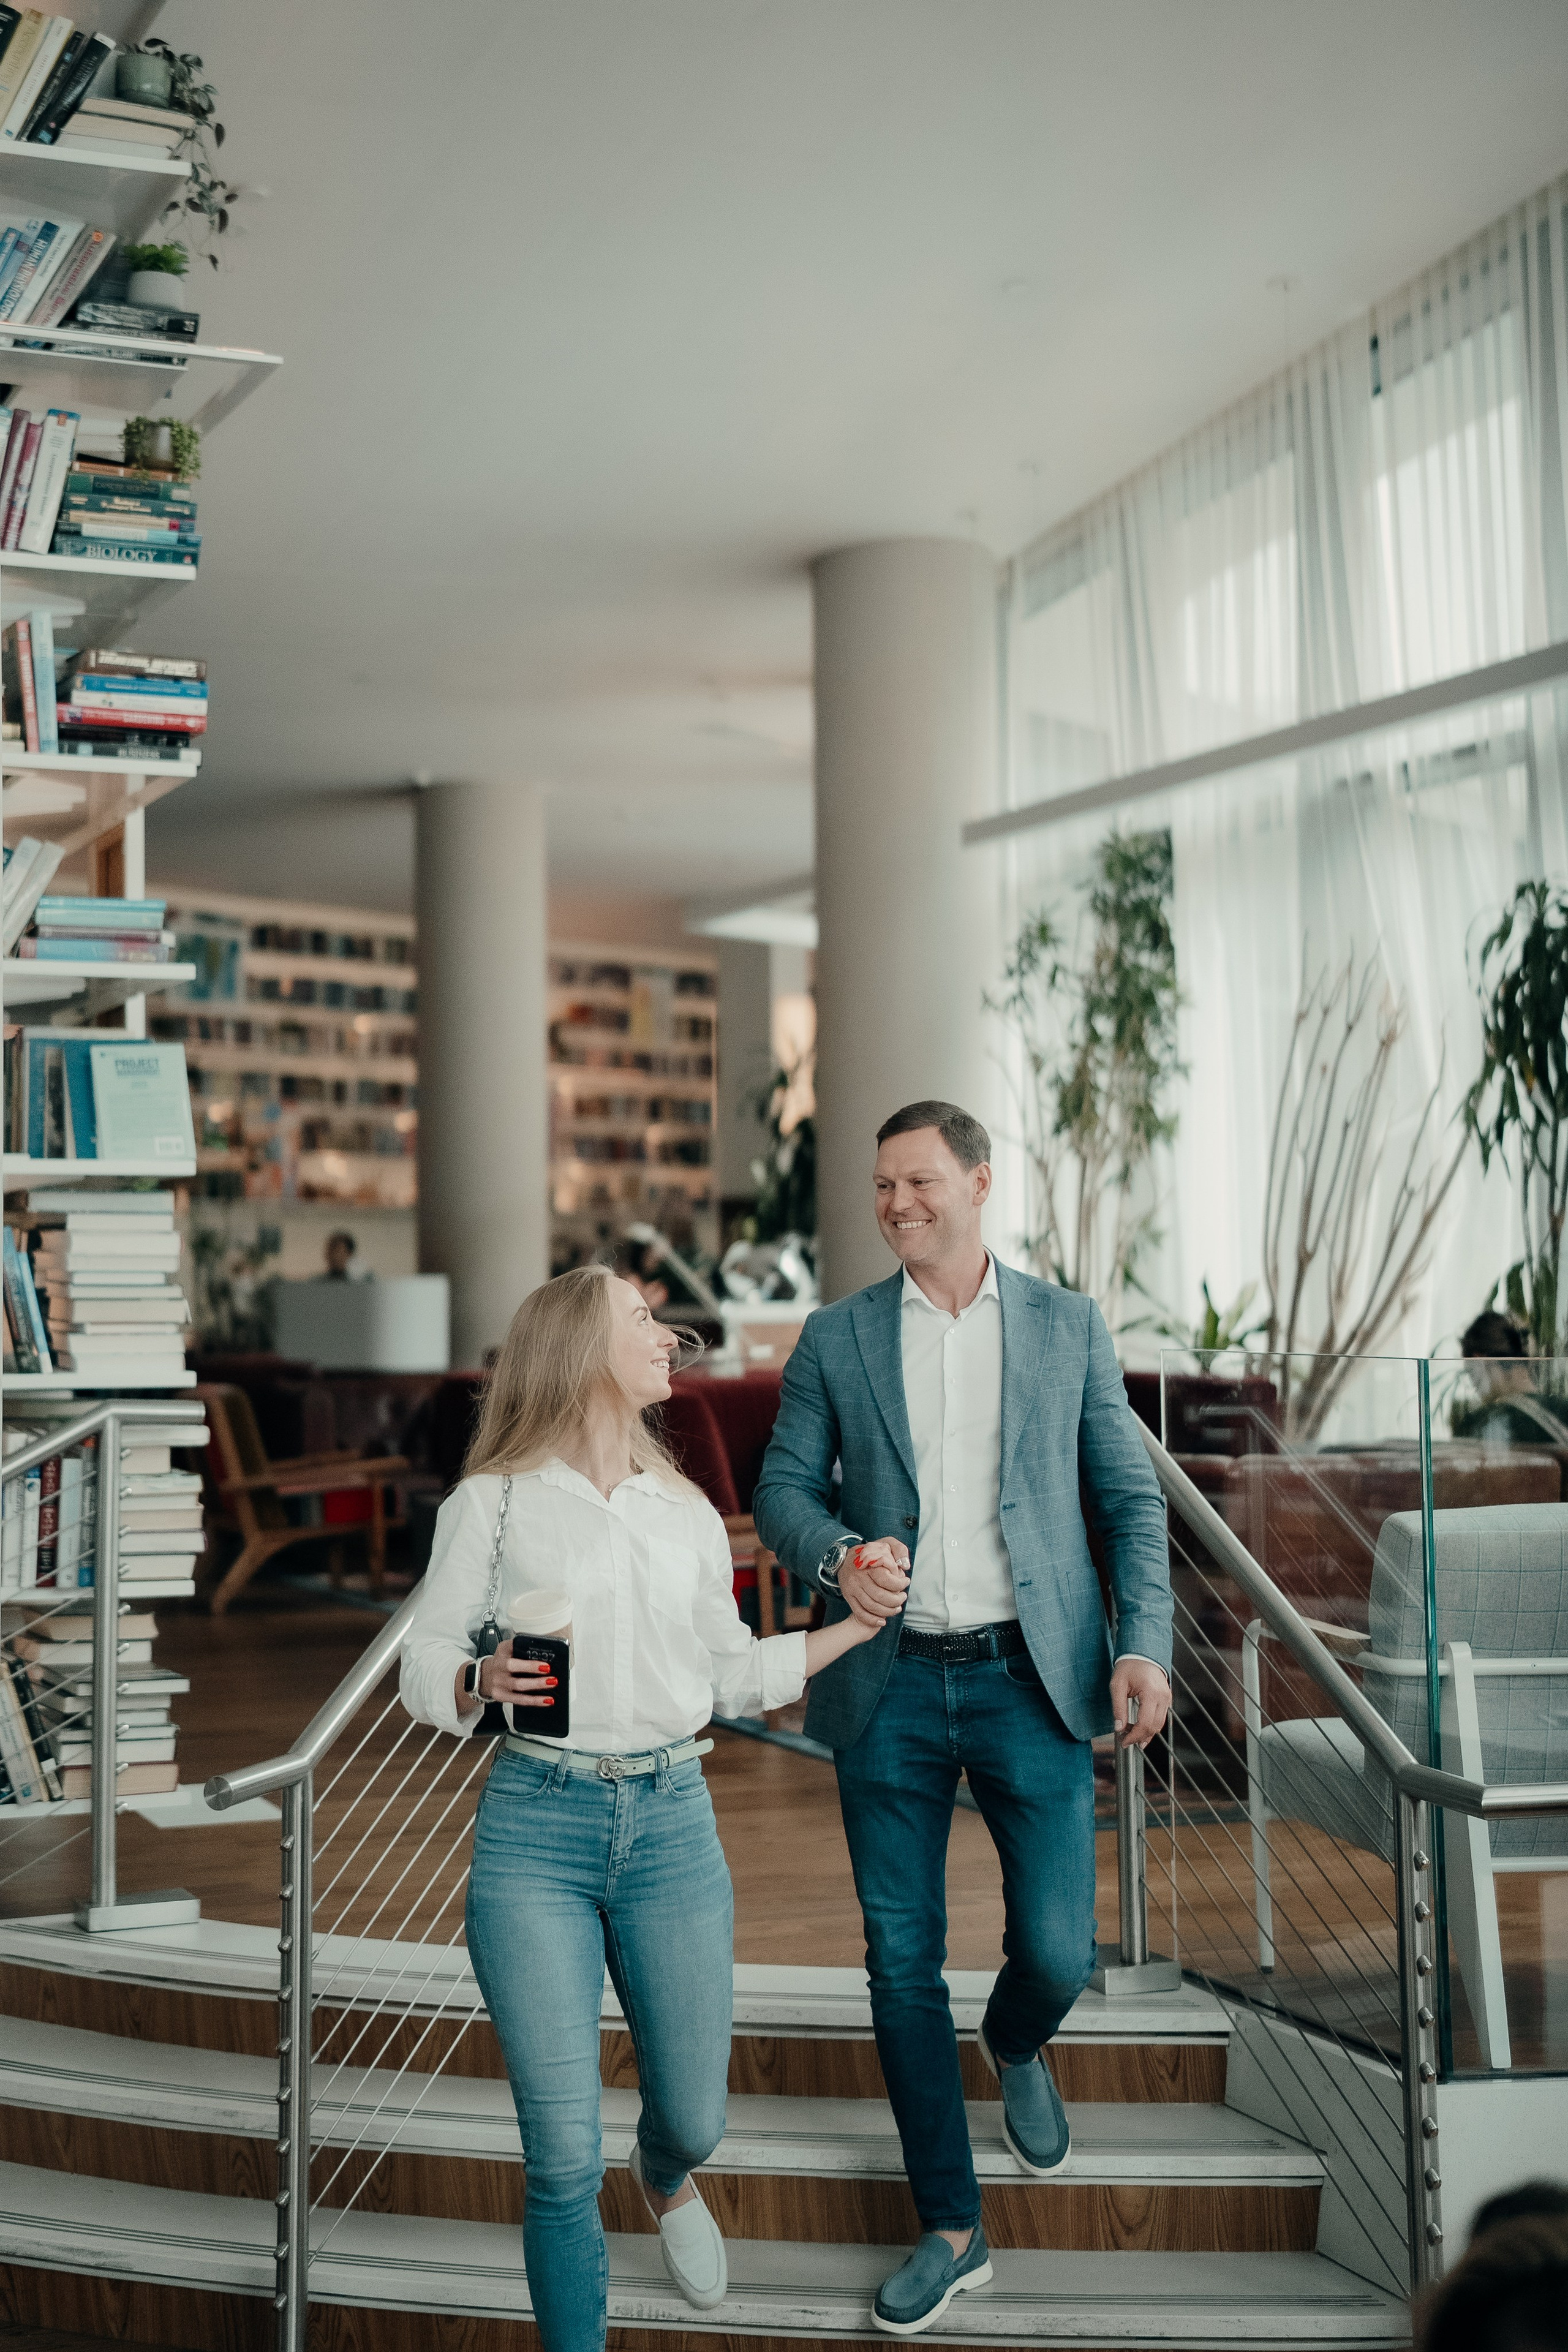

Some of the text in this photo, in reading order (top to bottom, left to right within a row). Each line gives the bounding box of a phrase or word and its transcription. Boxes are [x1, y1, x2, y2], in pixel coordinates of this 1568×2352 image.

[23, 238, 48, 270] HUMAN
[86, 545, 157, 562] BIOLOGY
[115, 1058, 159, 1070] PROJECT
[526, 1650, 555, 1662] 12:37
